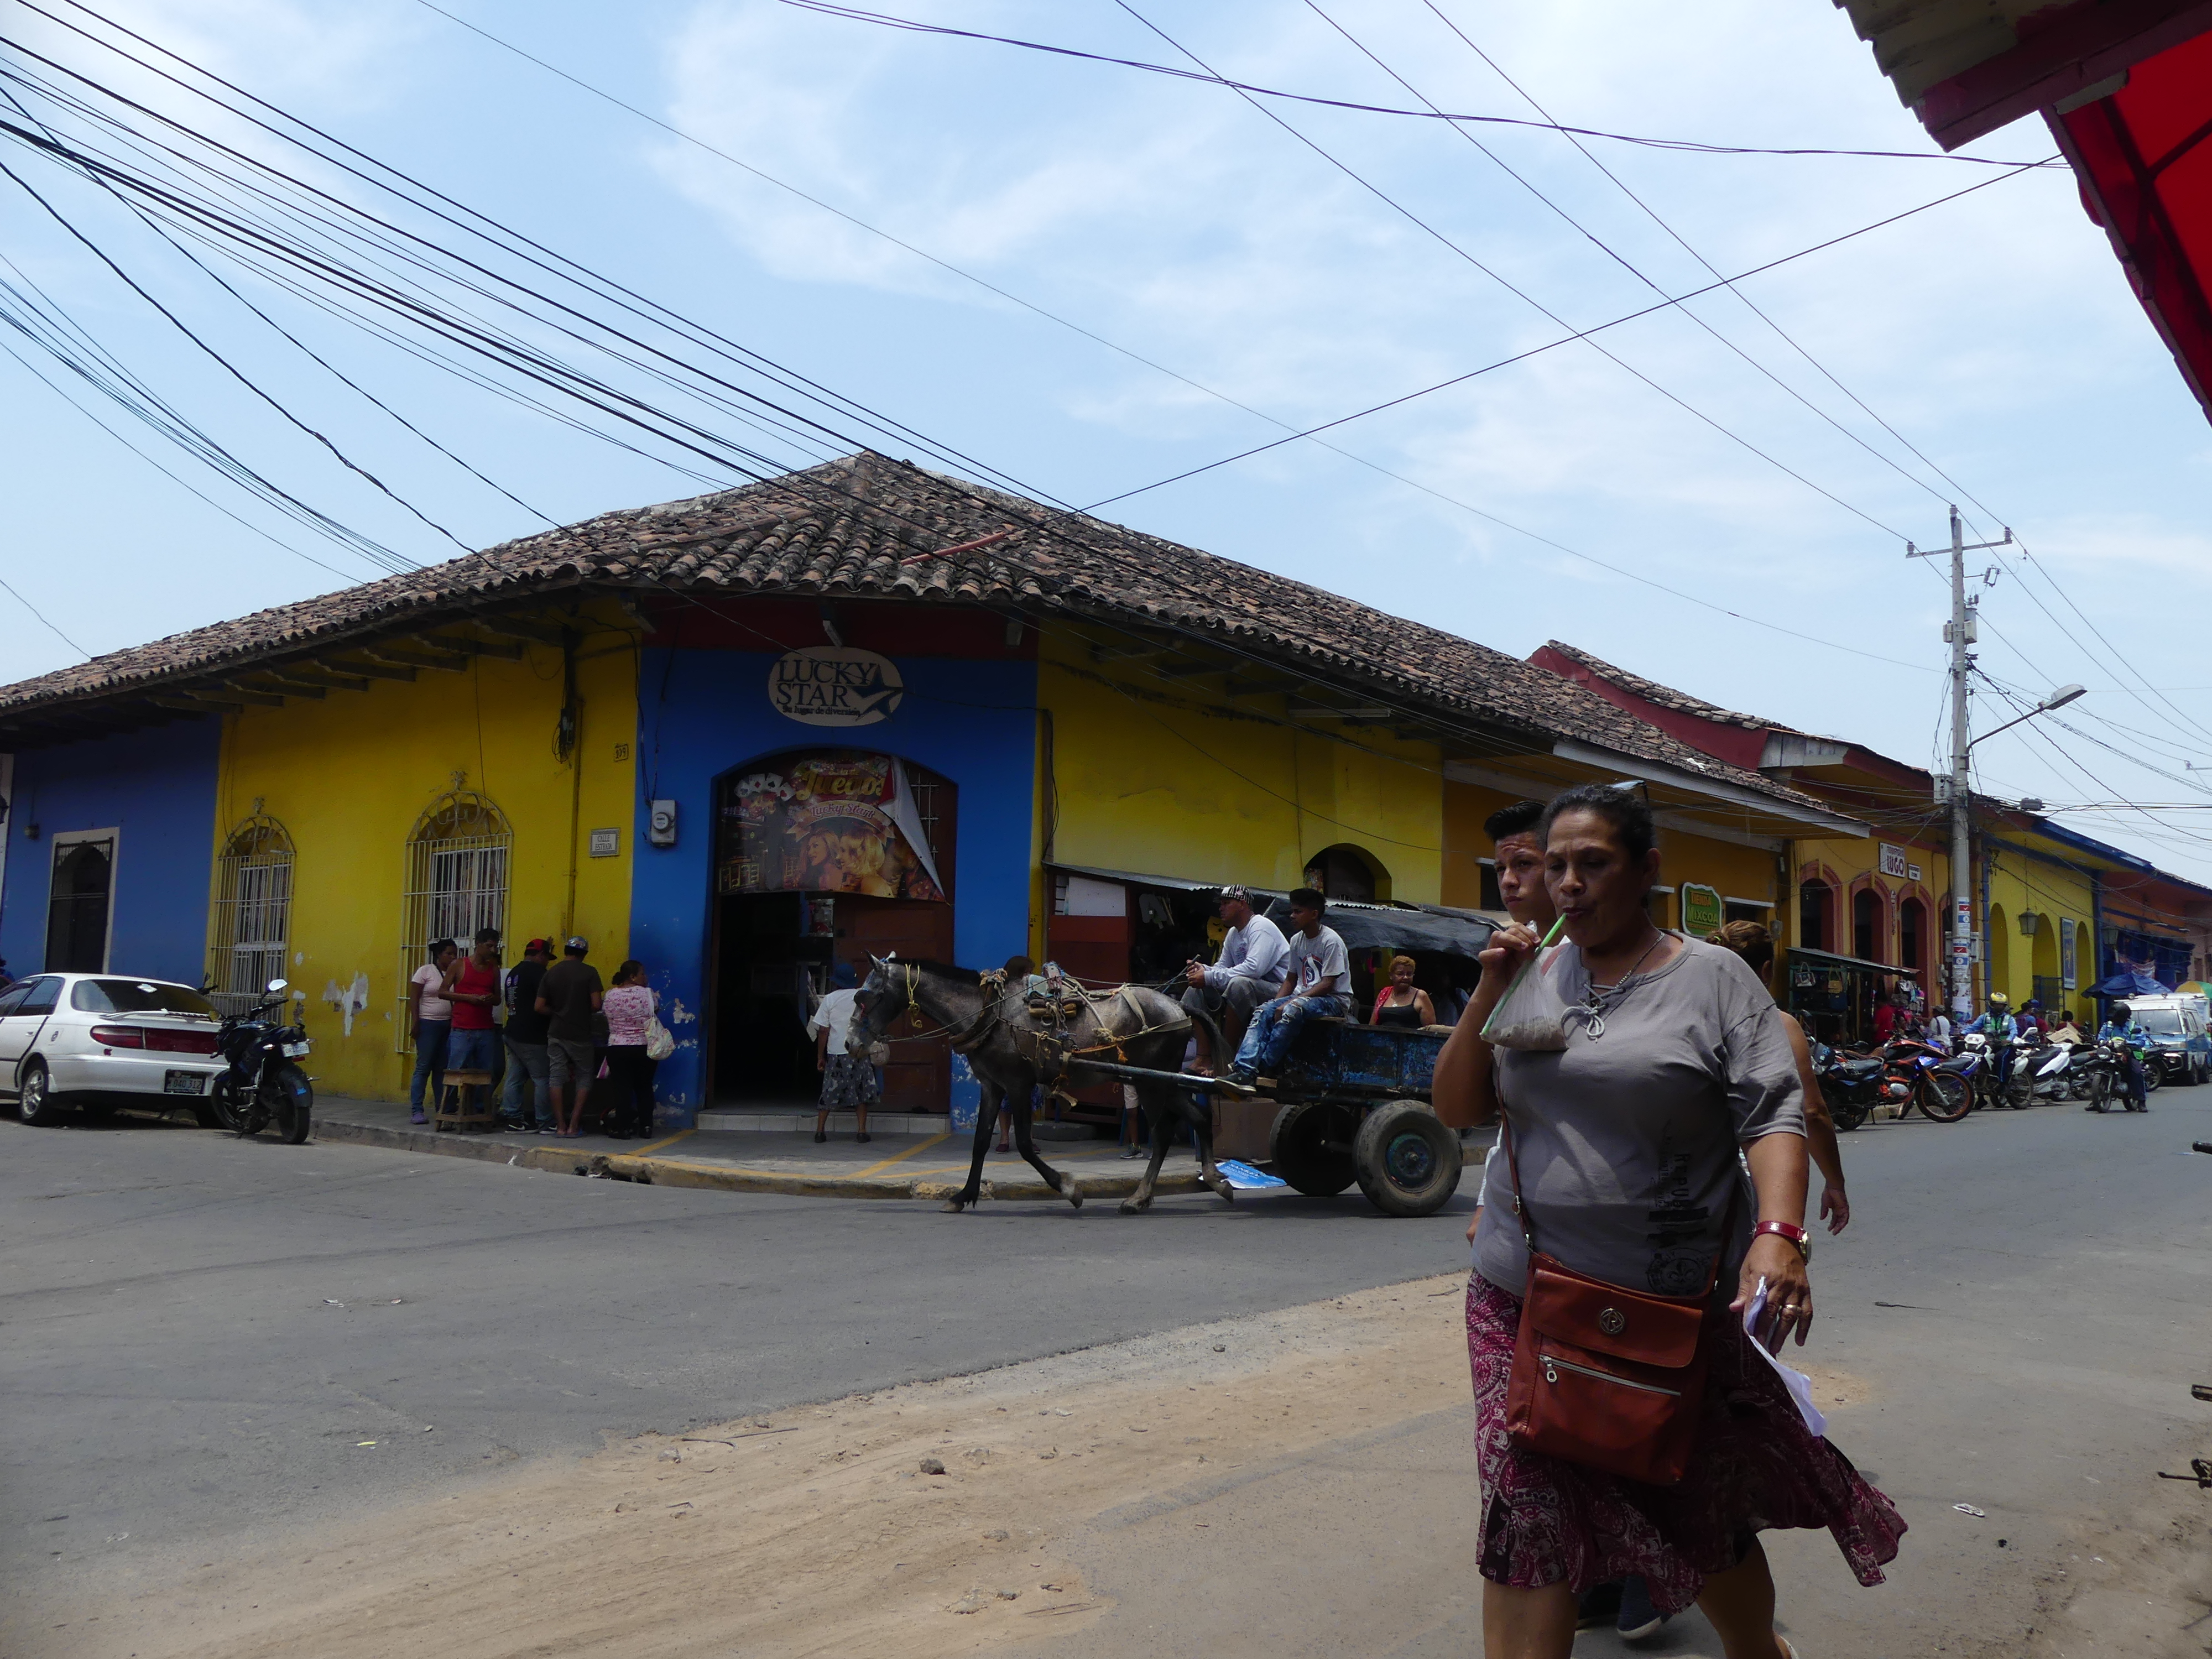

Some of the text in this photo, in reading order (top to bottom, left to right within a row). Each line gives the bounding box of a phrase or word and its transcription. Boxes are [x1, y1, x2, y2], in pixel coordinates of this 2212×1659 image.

[777, 659, 877, 685] LUCKY
[777, 682, 851, 707] STAR
[794, 706, 813, 716] lugar
[810, 803, 876, 819] Lucky Start
[1689, 892, 1712, 907] TIENDA
